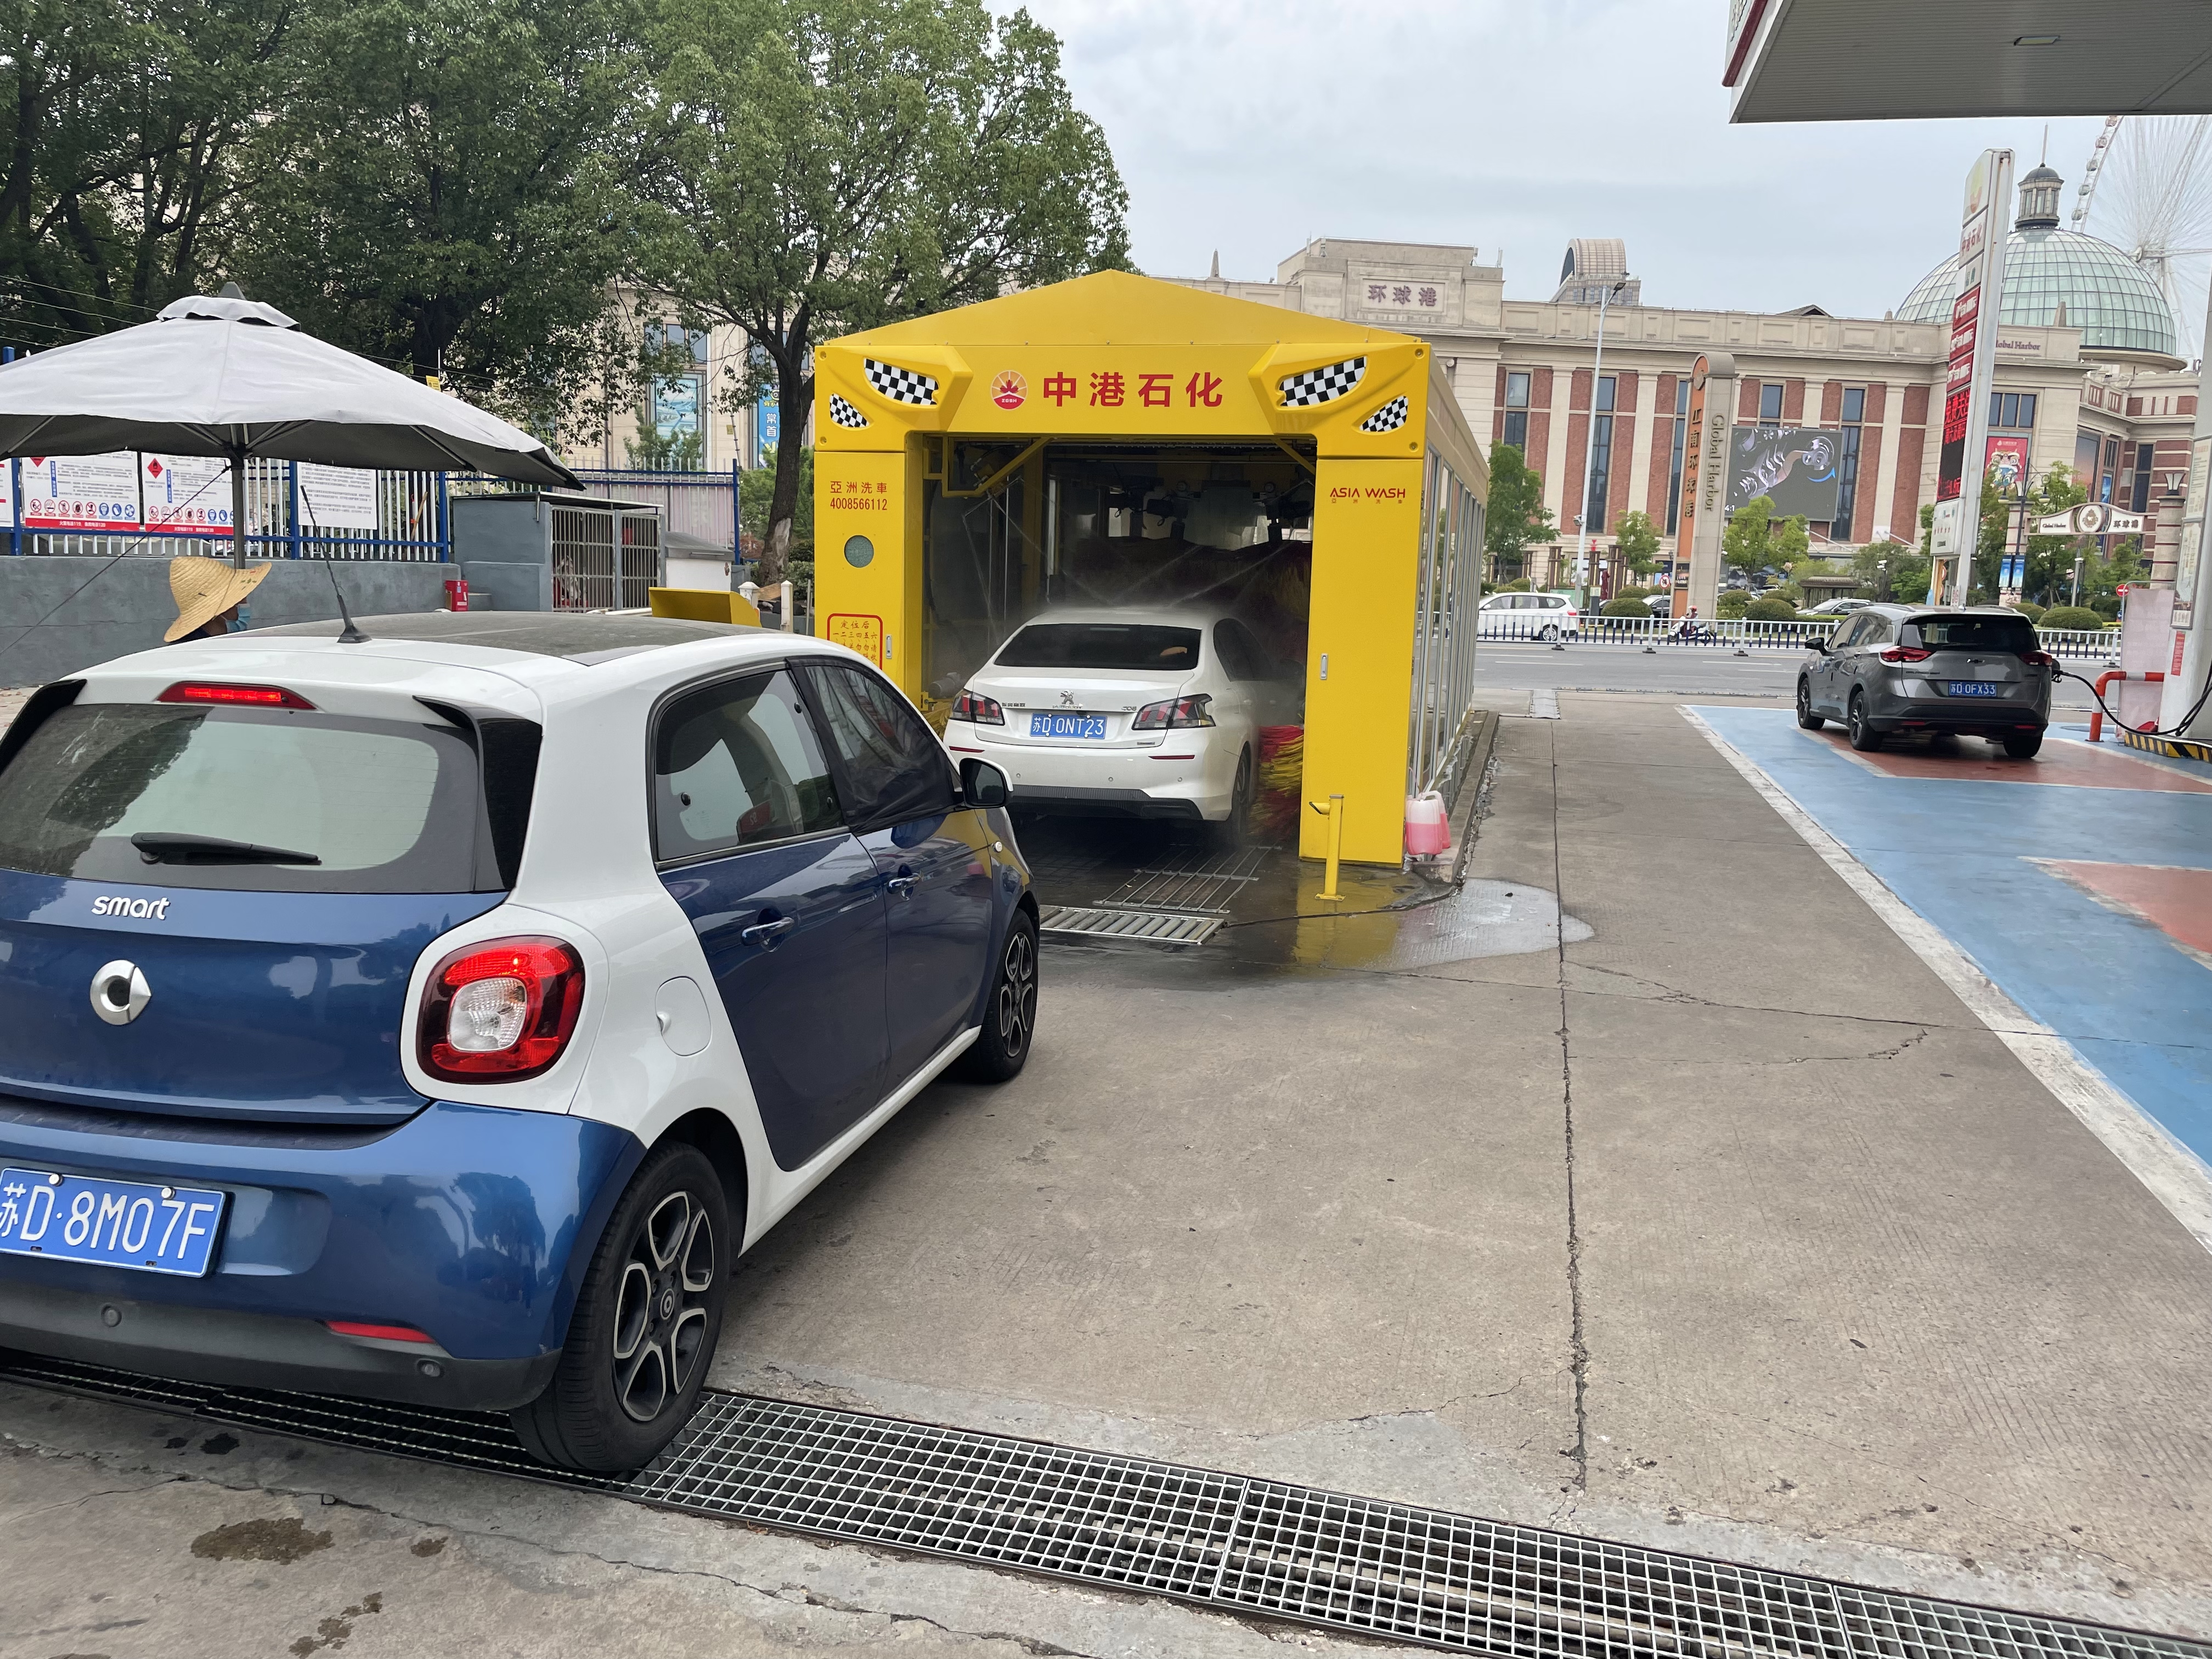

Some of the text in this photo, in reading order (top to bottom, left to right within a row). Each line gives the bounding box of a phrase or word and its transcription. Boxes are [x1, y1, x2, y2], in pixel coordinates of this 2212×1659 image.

[1368, 284, 1437, 307] 环球港
[1995, 340, 2041, 350] lobal Harbor
[1043, 371, 1223, 408] 中港石化
[1705, 413, 1725, 511] Global Harbor
[830, 481, 888, 494] 亞洲洗車
[1329, 487, 1406, 499] ASIA WASH
[830, 497, 888, 511] 4008566112
[840, 619, 870, 629] 定位后
[91, 895, 171, 920] smart
